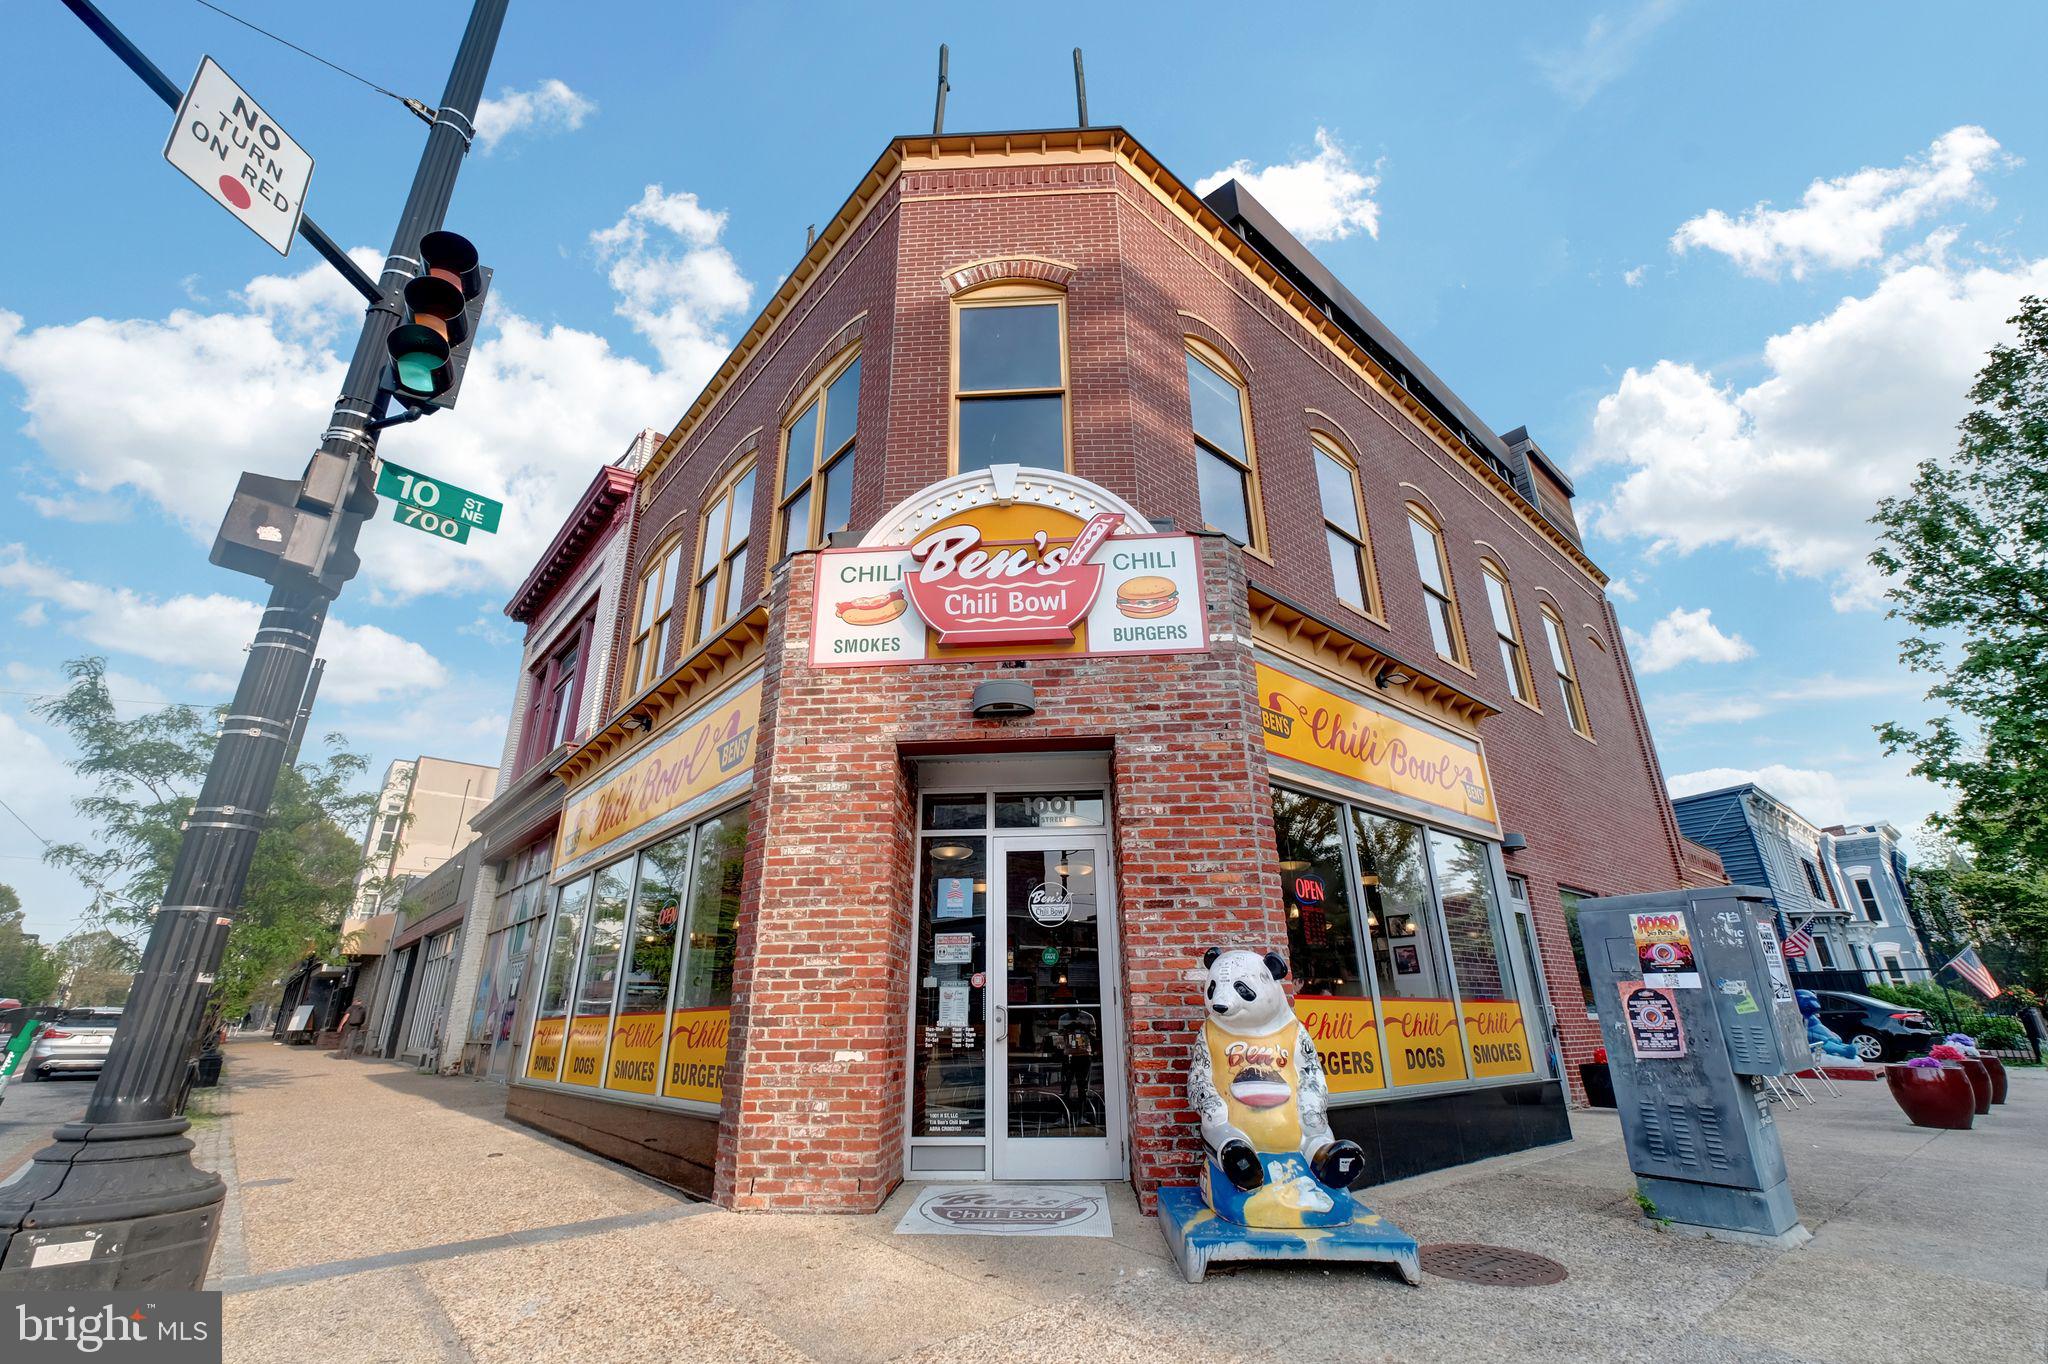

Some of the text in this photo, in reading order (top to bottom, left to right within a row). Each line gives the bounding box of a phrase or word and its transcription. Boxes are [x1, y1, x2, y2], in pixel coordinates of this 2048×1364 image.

[231, 95, 281, 151] NO
[218, 110, 284, 183] TURN
[191, 120, 289, 214] ON RED
[397, 474, 485, 512] 10 ST
[403, 505, 459, 539] 700
[461, 508, 484, 525] NE
[911, 525, 1073, 584] Ben's
[1112, 551, 1177, 571] CHILI
[841, 564, 903, 584] CHILI
[944, 590, 1068, 615] Chili Bowl
[1113, 625, 1188, 642] BURGERS
[834, 637, 901, 654] SMOKES
[1311, 707, 1455, 790] Chili Bowl
[639, 723, 711, 812] Bowl
[1023, 796, 1077, 815] 1001
[1032, 816, 1038, 824] H
[1032, 890, 1064, 904] Ben's
[1295, 878, 1325, 901] OPEN
[1035, 907, 1065, 916] Chili Bowl
[625, 1022, 658, 1048] Chili
[687, 1018, 728, 1049] Chili
[1304, 1012, 1355, 1040] Chili
[1402, 1012, 1443, 1038] Chili
[1478, 1012, 1512, 1035] Chili
[534, 1056, 556, 1072] BOWLS
[1225, 1041, 1288, 1068] Ben's
[1317, 1051, 1375, 1075] RGERS
[1405, 1047, 1445, 1069] DOGS
[1473, 1043, 1522, 1064] SMOKES
[573, 1057, 595, 1075] DOGS
[614, 1060, 655, 1082] SMOKES
[672, 1063, 725, 1089] BURGER
[940, 1193, 1061, 1206] Ben's
[946, 1210, 1067, 1219] Chili Bowl
